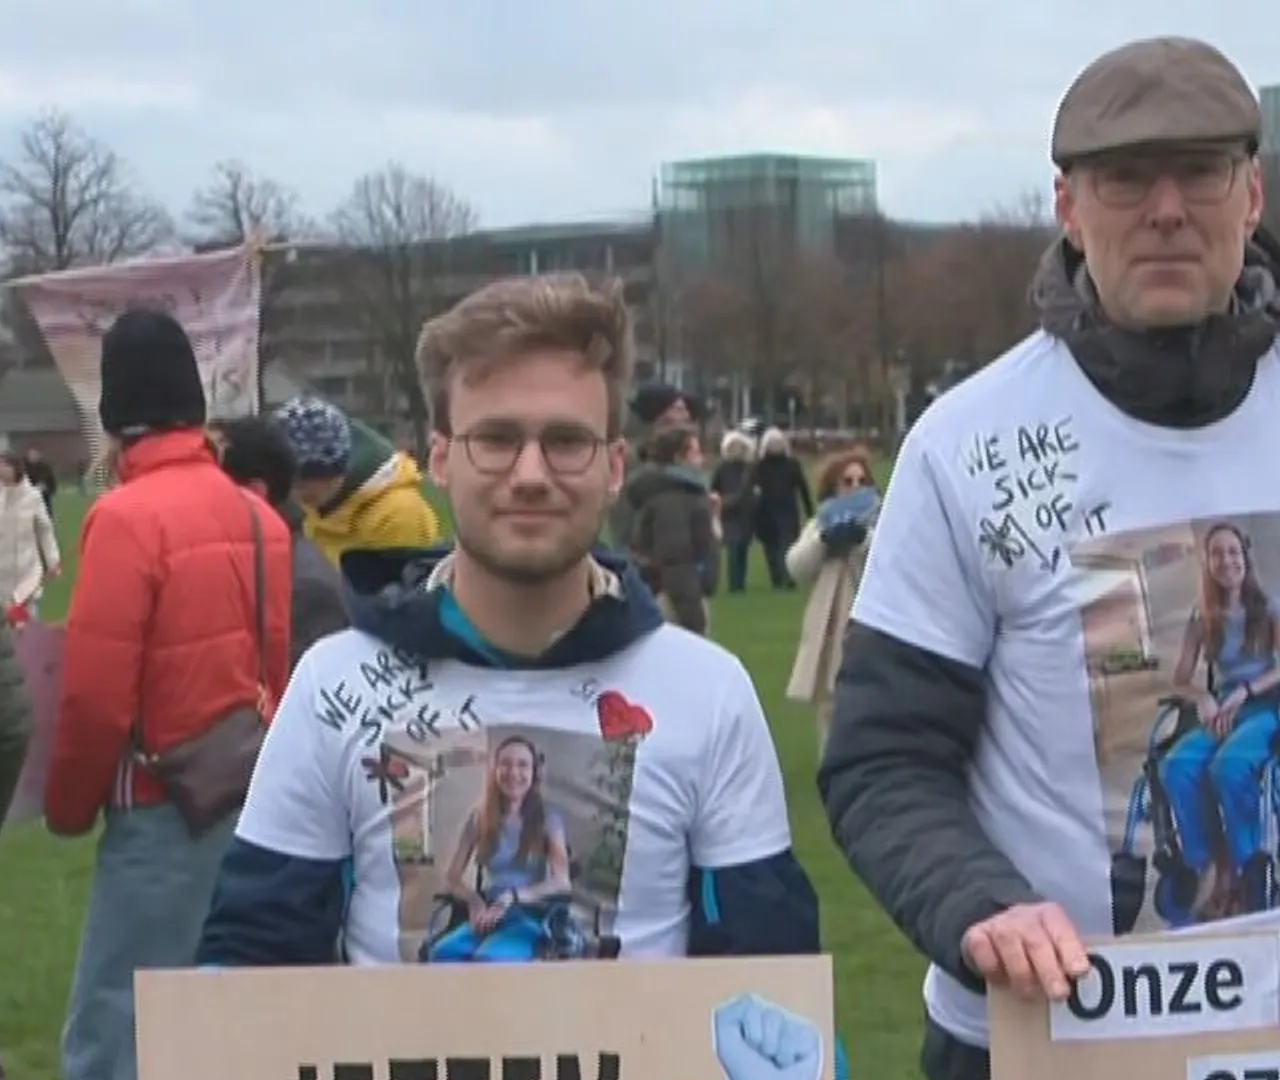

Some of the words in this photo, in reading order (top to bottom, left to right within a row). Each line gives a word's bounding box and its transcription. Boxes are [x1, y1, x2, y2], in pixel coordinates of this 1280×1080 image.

[960, 432, 1008, 478] WE
[1018, 414, 1080, 462] ARE
[1035, 494, 1073, 533] OF
[315, 679, 362, 732] WE
[360, 645, 420, 691] ARE
[406, 704, 441, 743] OF
[1065, 952, 1245, 1021] Onze
